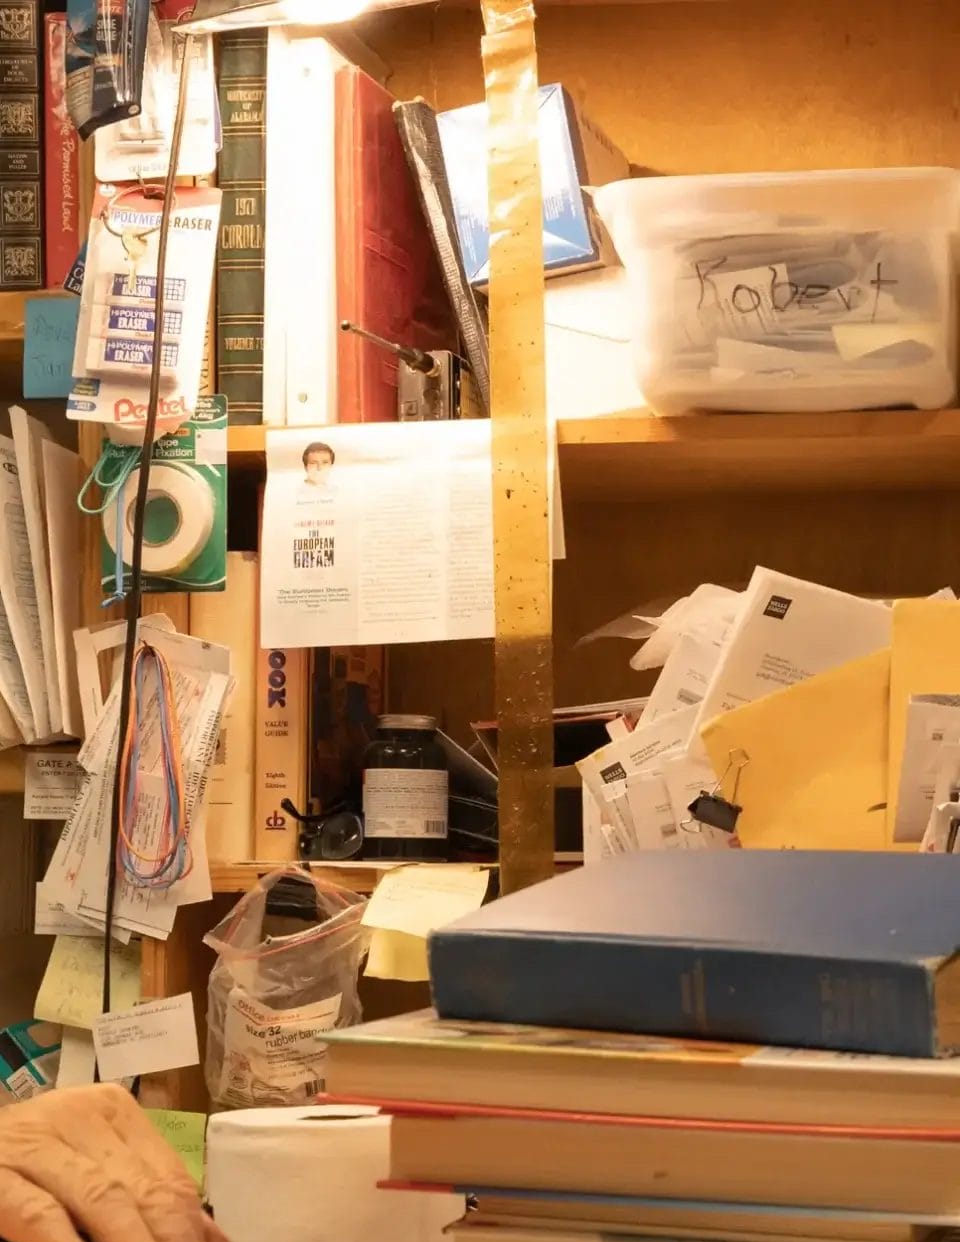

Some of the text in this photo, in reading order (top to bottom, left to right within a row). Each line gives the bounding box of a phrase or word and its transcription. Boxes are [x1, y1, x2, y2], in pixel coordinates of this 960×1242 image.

[691, 254, 900, 325] Robert
[117, 317, 148, 330] ERASER
[114, 350, 145, 363] ERASER
[113, 396, 187, 422] Petel
[293, 536, 335, 551] EUROPEAN
[293, 549, 335, 569] DREAM
[264, 720, 289, 729] VALUE
[264, 729, 289, 738] GUIDE
[36, 759, 64, 769] GATE
[245, 1024, 281, 1039] size 32
[265, 1033, 298, 1049] rubber
